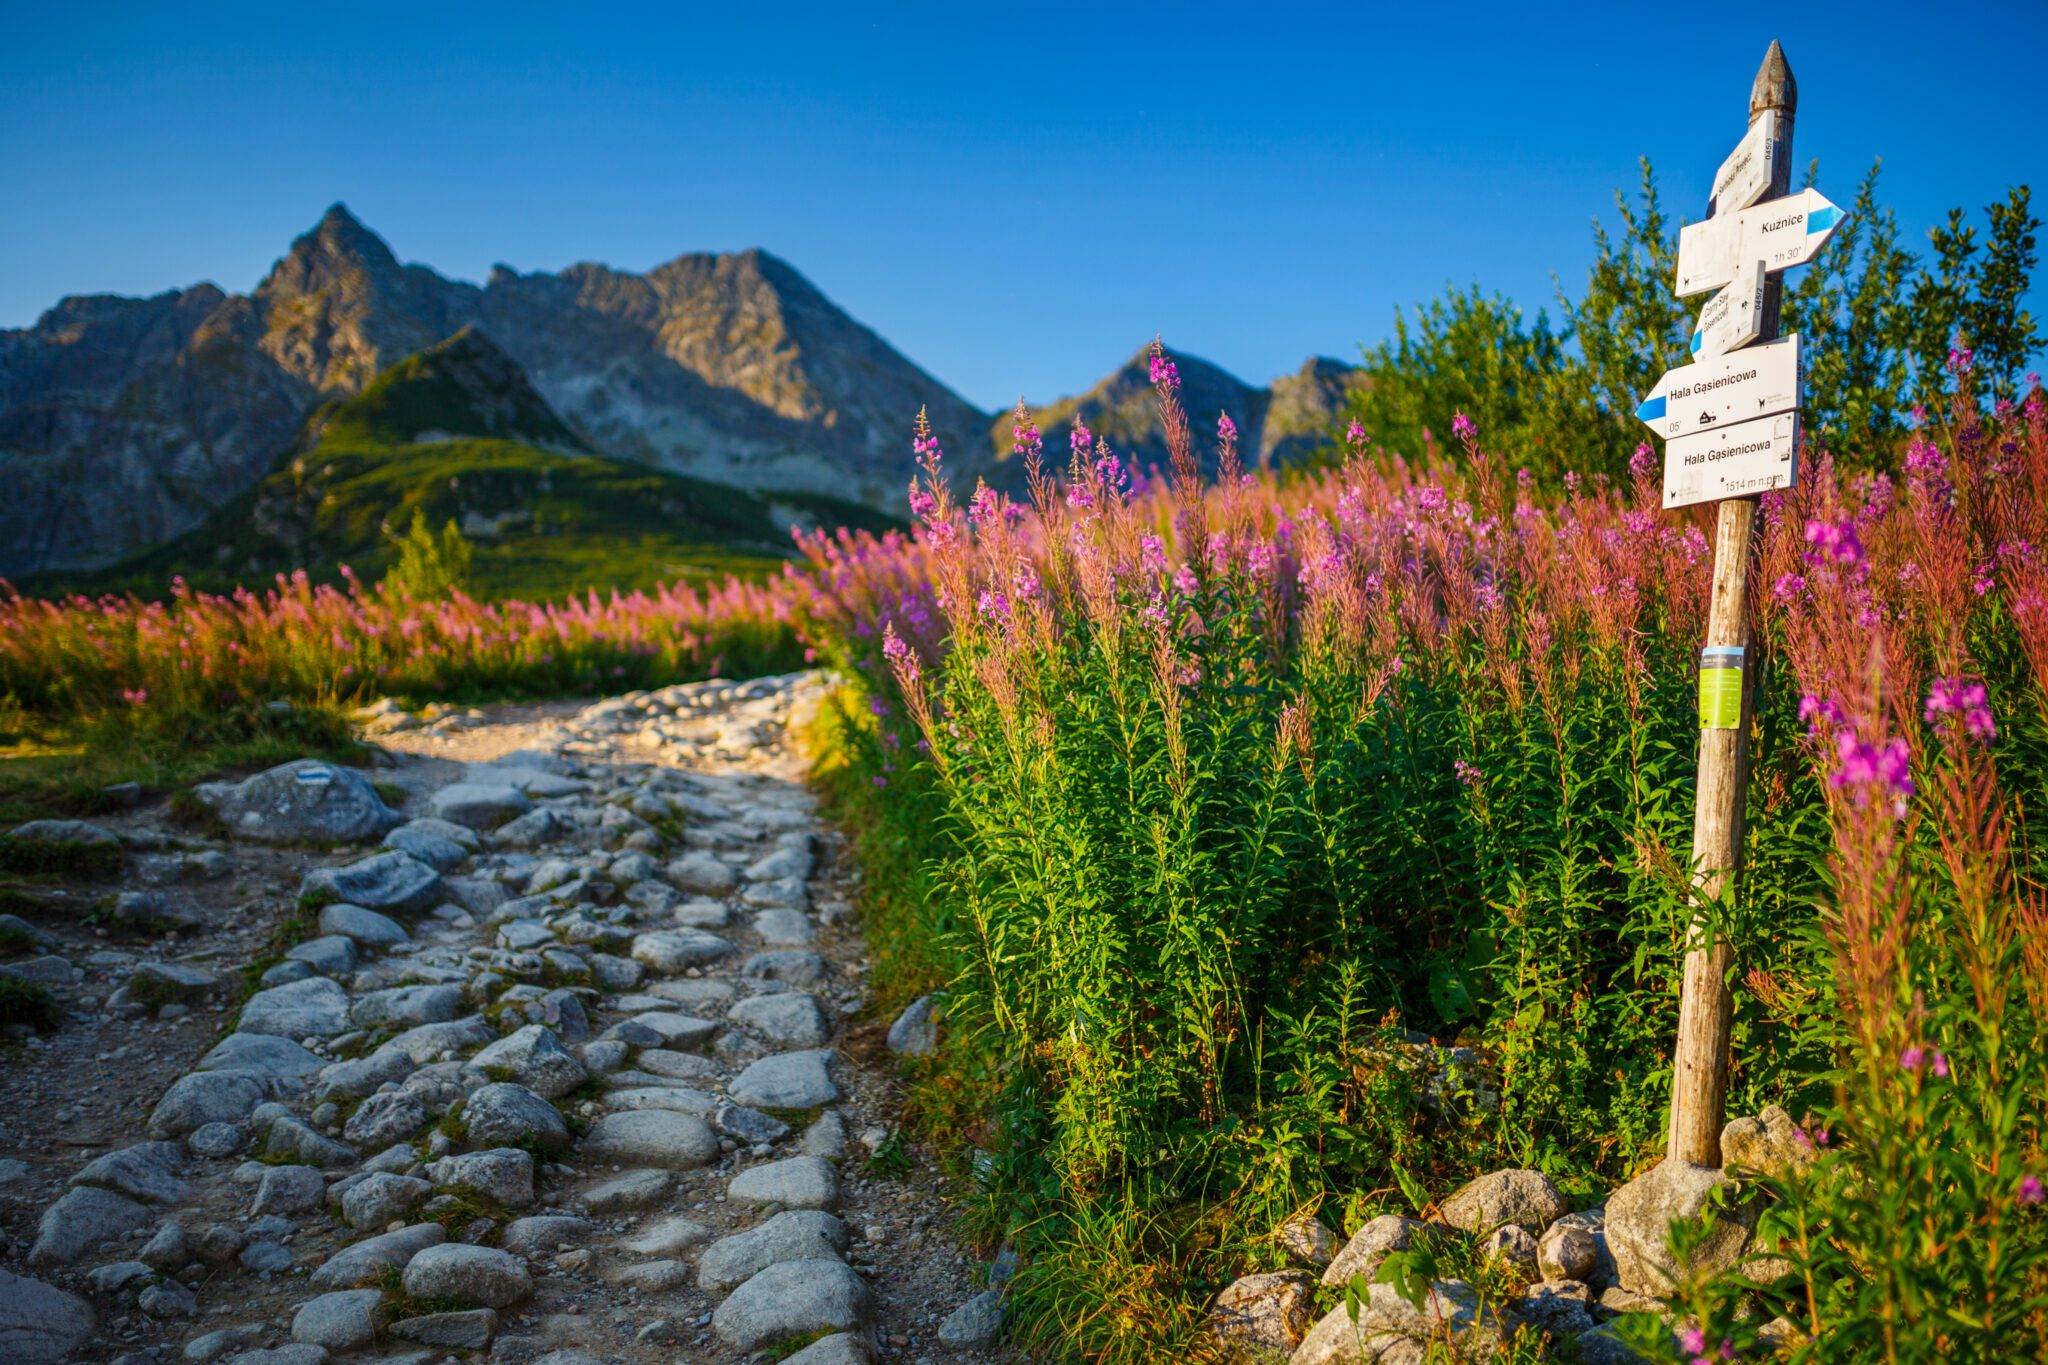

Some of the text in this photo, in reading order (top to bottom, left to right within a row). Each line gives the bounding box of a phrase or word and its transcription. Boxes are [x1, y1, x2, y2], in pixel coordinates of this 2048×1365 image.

[1774, 254, 1787, 263] 1h
[1670, 369, 1757, 401] Hala Gąsienicowa
[1684, 440, 1771, 467] Hala Gąsienicowa
[1725, 480, 1745, 492] 1514
[1747, 479, 1756, 488] m
